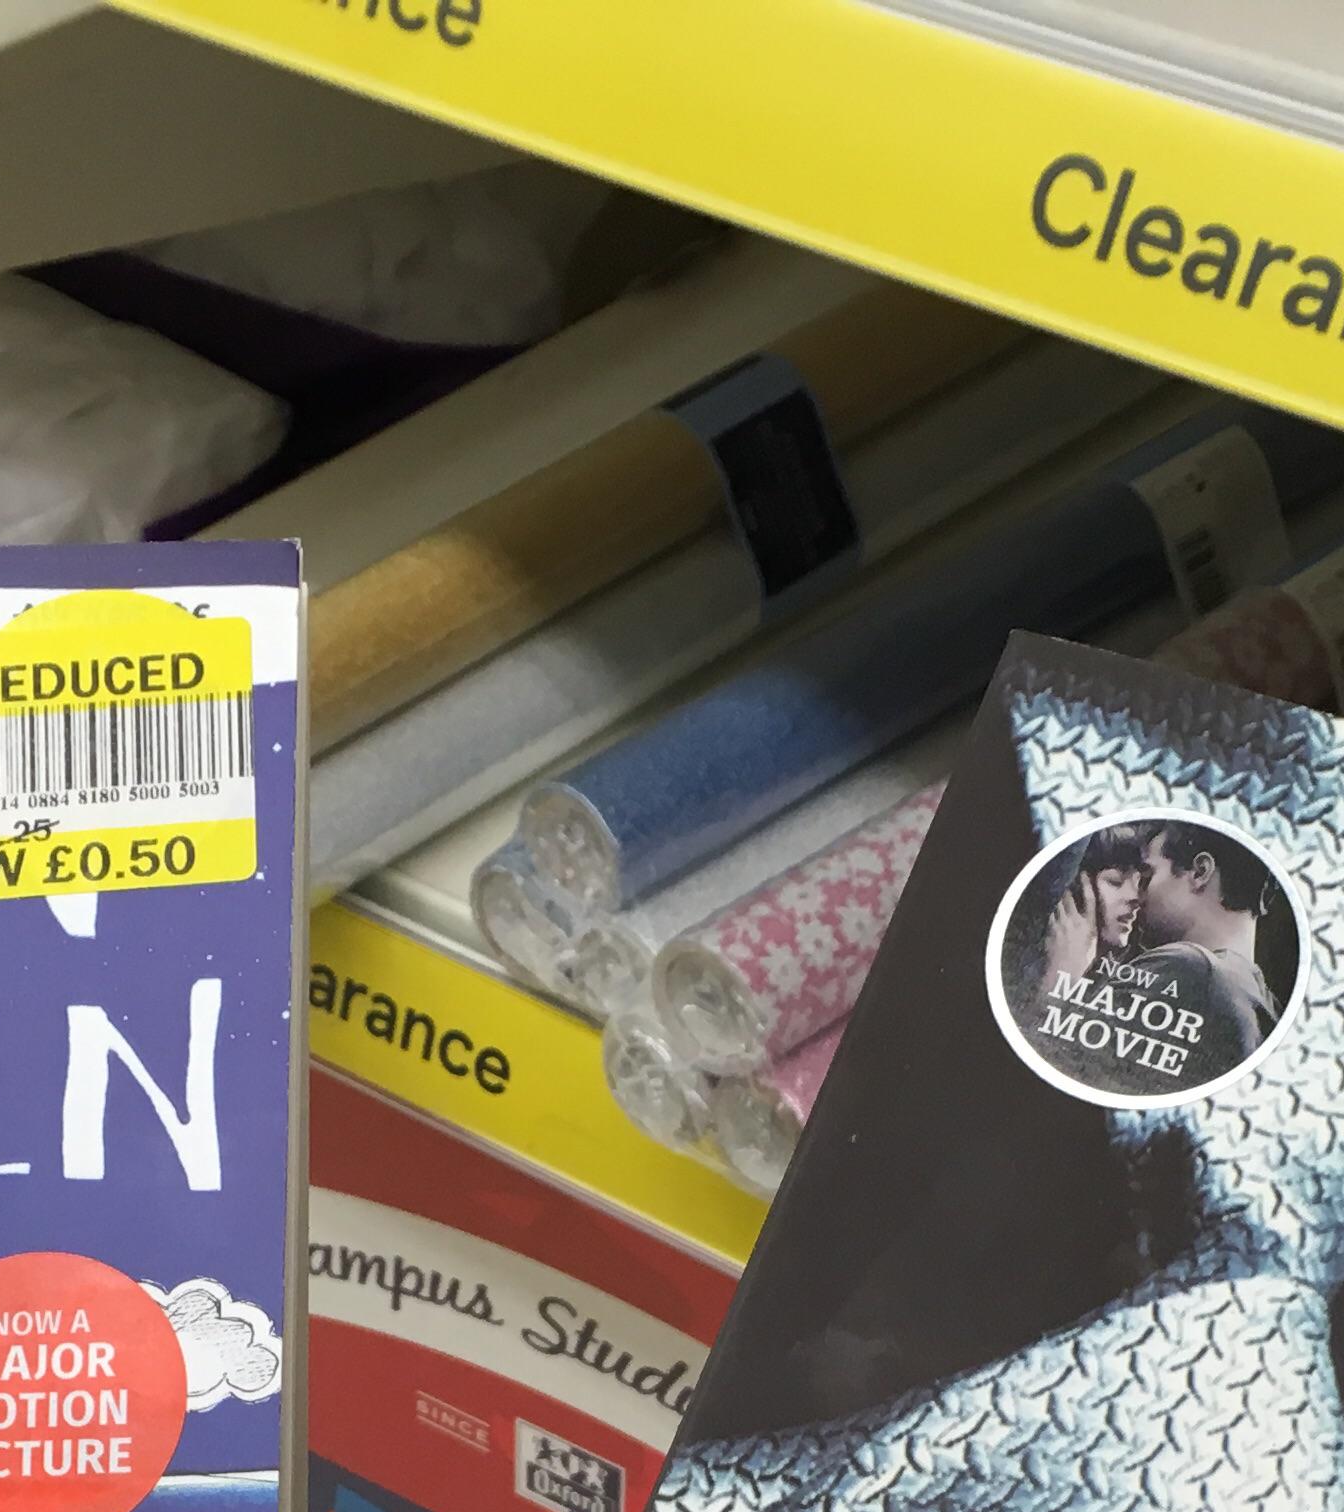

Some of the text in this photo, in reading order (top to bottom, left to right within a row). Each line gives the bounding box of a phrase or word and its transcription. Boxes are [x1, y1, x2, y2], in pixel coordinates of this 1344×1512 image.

[79, 789, 120, 805] 8180
[129, 785, 170, 802] 5000
[179, 781, 220, 798] 5003
[43, 836, 195, 884] £0.50
[1096, 956, 1179, 999] NOW A
[308, 963, 511, 1095] arance
[1048, 969, 1205, 1044] MAJOR
[1037, 1005, 1189, 1077] MOVIE
[70, 1309, 91, 1334] A
[416, 1399, 489, 1446] SINCE
